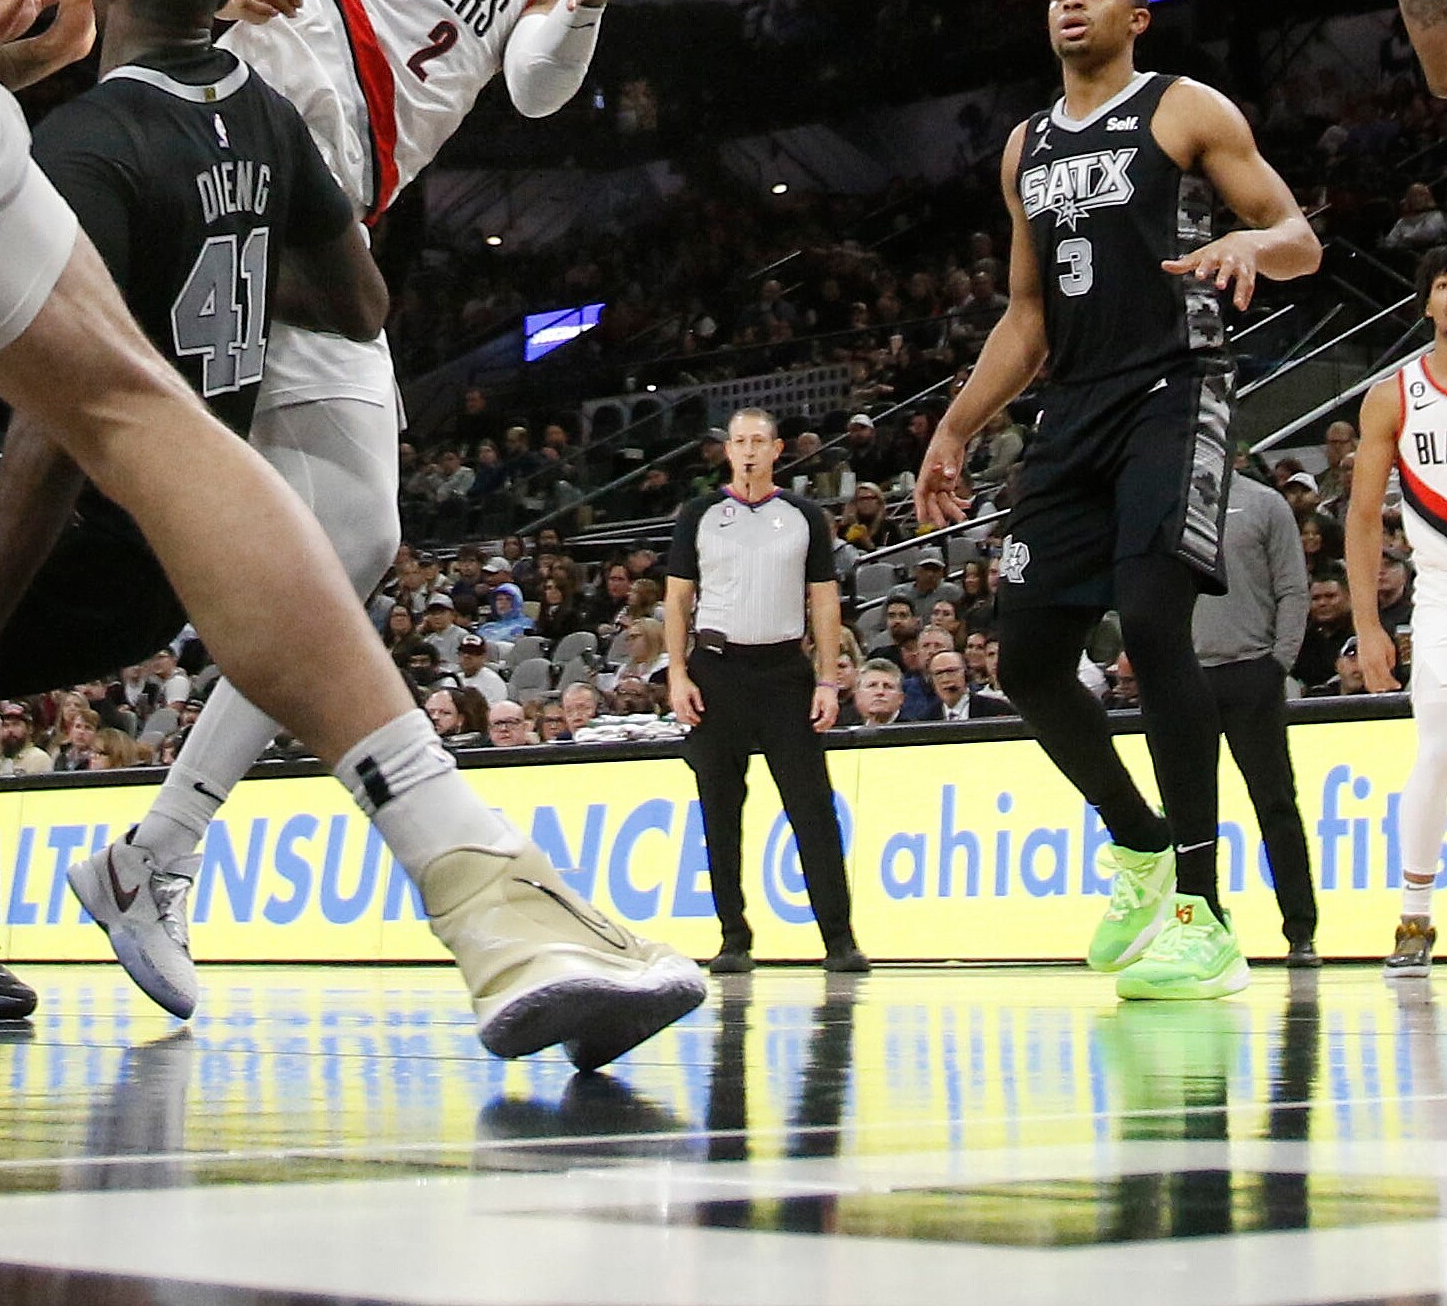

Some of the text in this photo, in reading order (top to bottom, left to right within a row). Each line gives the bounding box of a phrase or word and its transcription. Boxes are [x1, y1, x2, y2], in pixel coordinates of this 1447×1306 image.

[406, 20, 458, 82] 2
[1036, 117, 1049, 133] 6
[1106, 116, 1139, 131] Self.
[196, 160, 271, 225] DIENG
[1021, 148, 1138, 221] SATX
[1056, 237, 1094, 297] 3
[171, 226, 270, 398] 41
